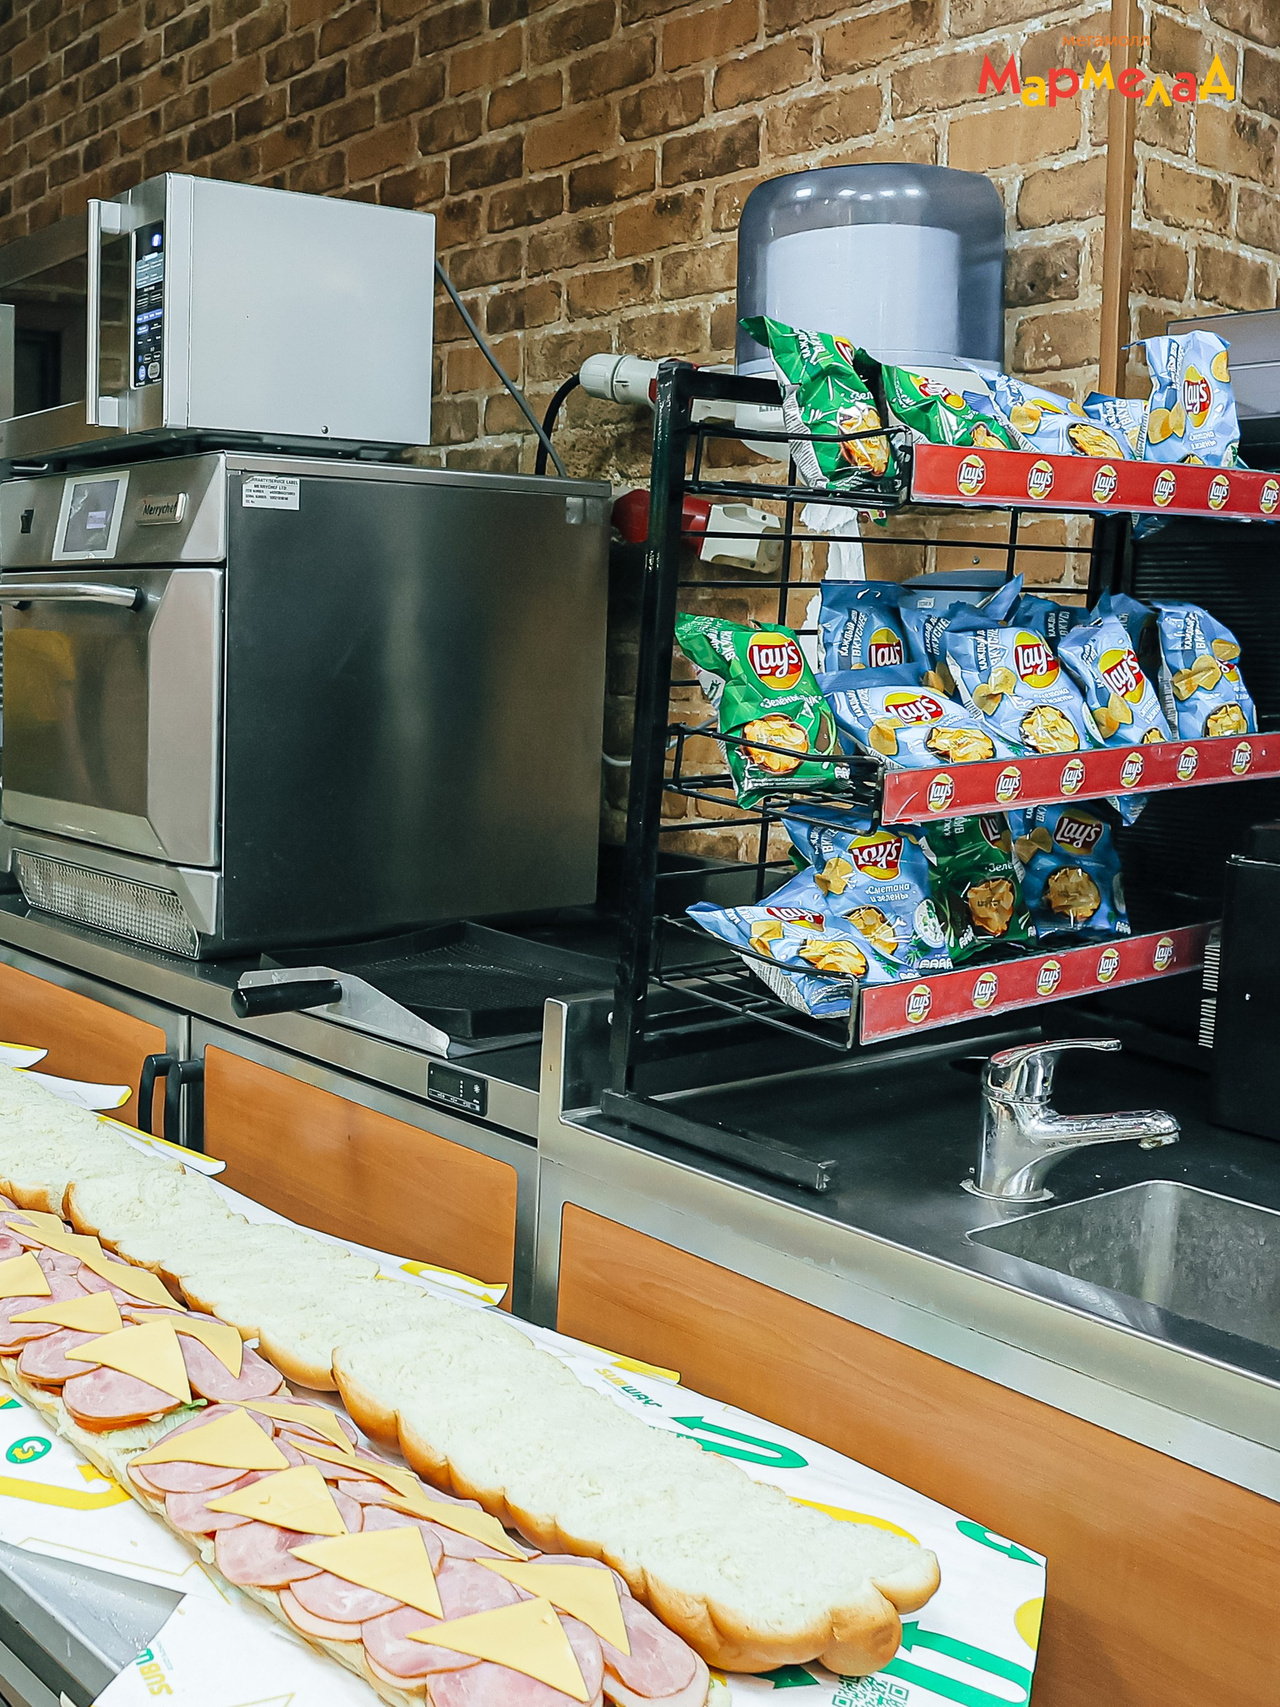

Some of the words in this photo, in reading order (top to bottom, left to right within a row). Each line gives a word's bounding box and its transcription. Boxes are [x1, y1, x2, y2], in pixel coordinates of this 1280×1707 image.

[1184, 379, 1209, 415] Lay's
[752, 642, 800, 678] Lay's
[1102, 648, 1140, 697] Lay's
[888, 698, 938, 721] Lay's
[1055, 817, 1098, 848] Lay's
[852, 838, 901, 869] Lay's
[594, 1367, 662, 1408] SUBWAY
[136, 1647, 173, 1696] SUBW
